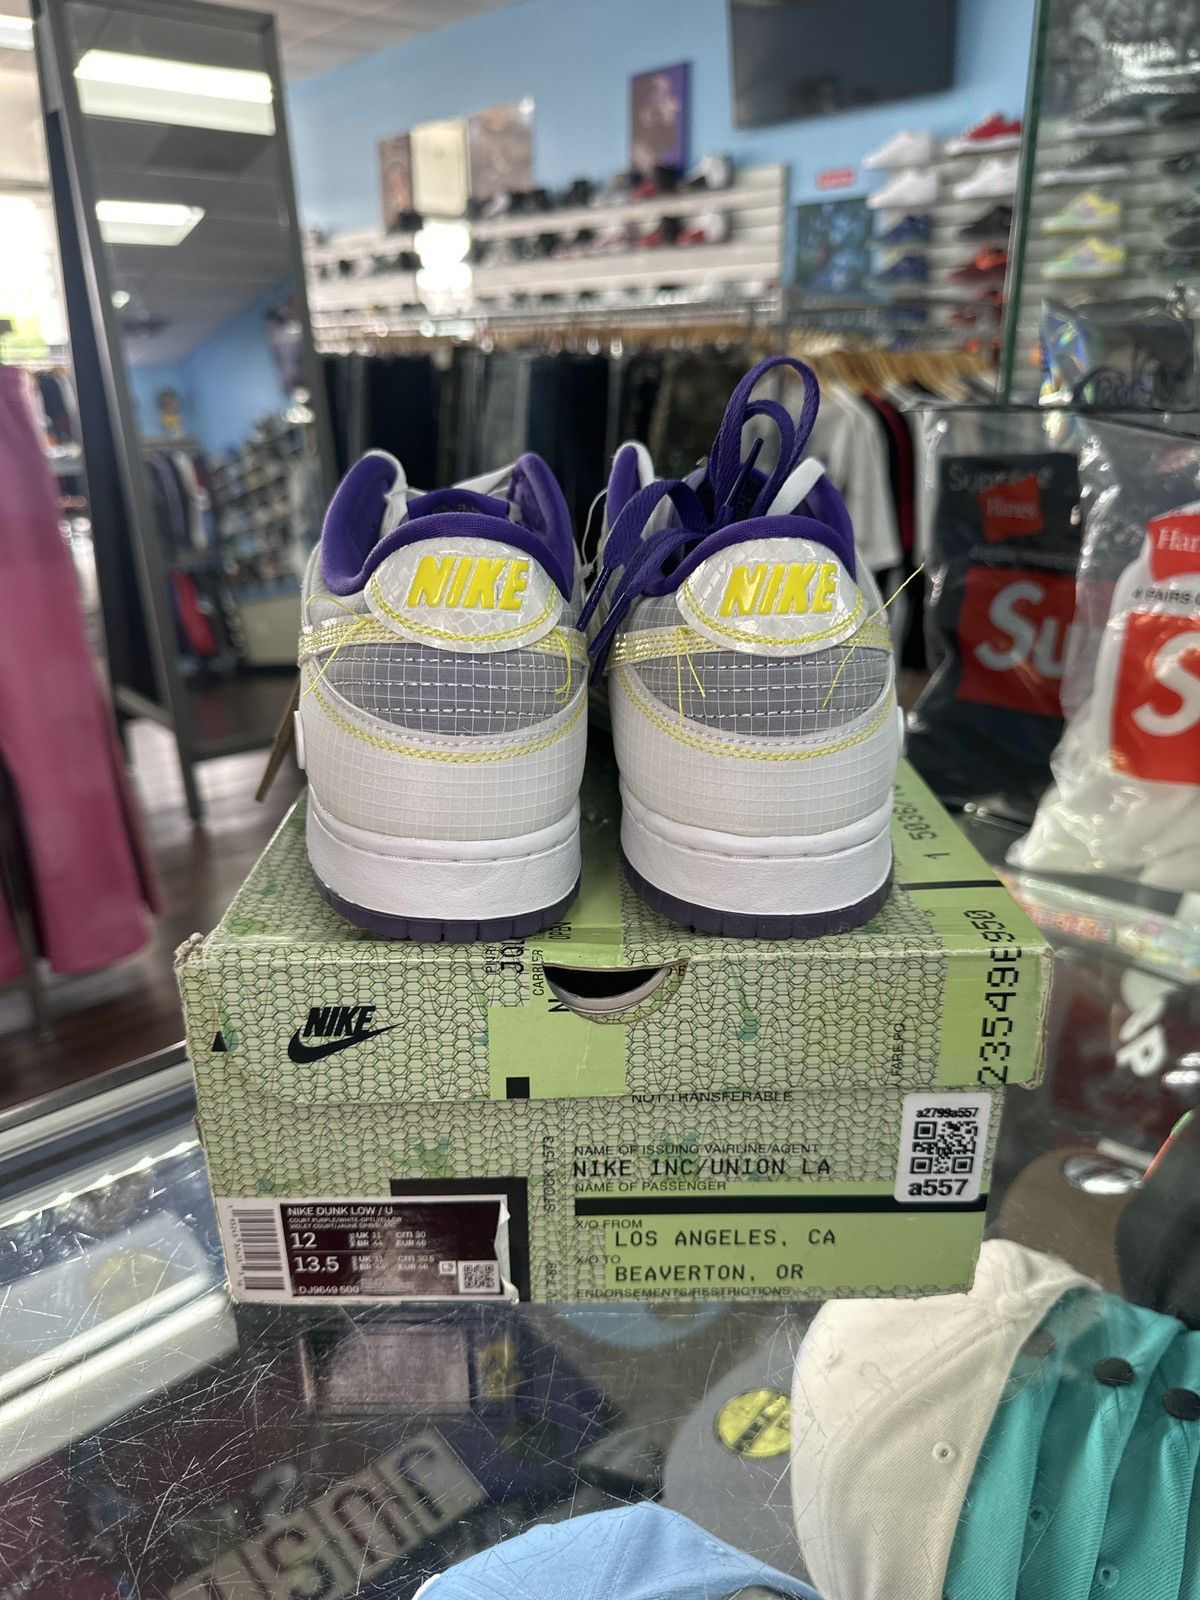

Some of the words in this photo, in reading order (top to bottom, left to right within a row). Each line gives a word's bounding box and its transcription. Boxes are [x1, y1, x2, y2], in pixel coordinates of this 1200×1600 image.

[407, 554, 530, 610] NIKE
[720, 562, 838, 617] NIKE
[302, 1006, 376, 1037] NIKE
[668, 1090, 793, 1103] TRANSFERABLE
[542, 1135, 555, 1166] 1573
[574, 1145, 614, 1156] NAME
[619, 1145, 638, 1155] OF
[641, 1144, 700, 1155] ISSUING
[573, 1160, 632, 1178] NIKE
[650, 1158, 786, 1177] INC/UNION
[801, 1158, 831, 1175] LA
[543, 1169, 556, 1212] STOCK
[574, 1183, 614, 1192] NAME
[618, 1182, 638, 1192] OF
[641, 1180, 727, 1192] PASSENGER
[908, 1179, 969, 1196] a557
[287, 1206, 314, 1216] NIKE
[316, 1206, 349, 1216] DUNK
[350, 1206, 376, 1215] LOW
[385, 1206, 394, 1215] U
[575, 1219, 599, 1230] X/O
[602, 1219, 643, 1230] FROM
[289, 1231, 318, 1249] 12
[356, 1231, 369, 1239] UK
[395, 1239, 414, 1247] EUR
[615, 1230, 658, 1247] LOS
[674, 1229, 788, 1247] ANGELES,
[807, 1229, 836, 1245] CA
[293, 1255, 340, 1273] 13.5
[576, 1255, 600, 1265] X/O
[603, 1254, 622, 1264] TO
[615, 1264, 756, 1283] BEAVERTON,
[775, 1264, 805, 1280] OR
[575, 1286, 791, 1299] ENDORSEMENTS/RESTRICTIONS
